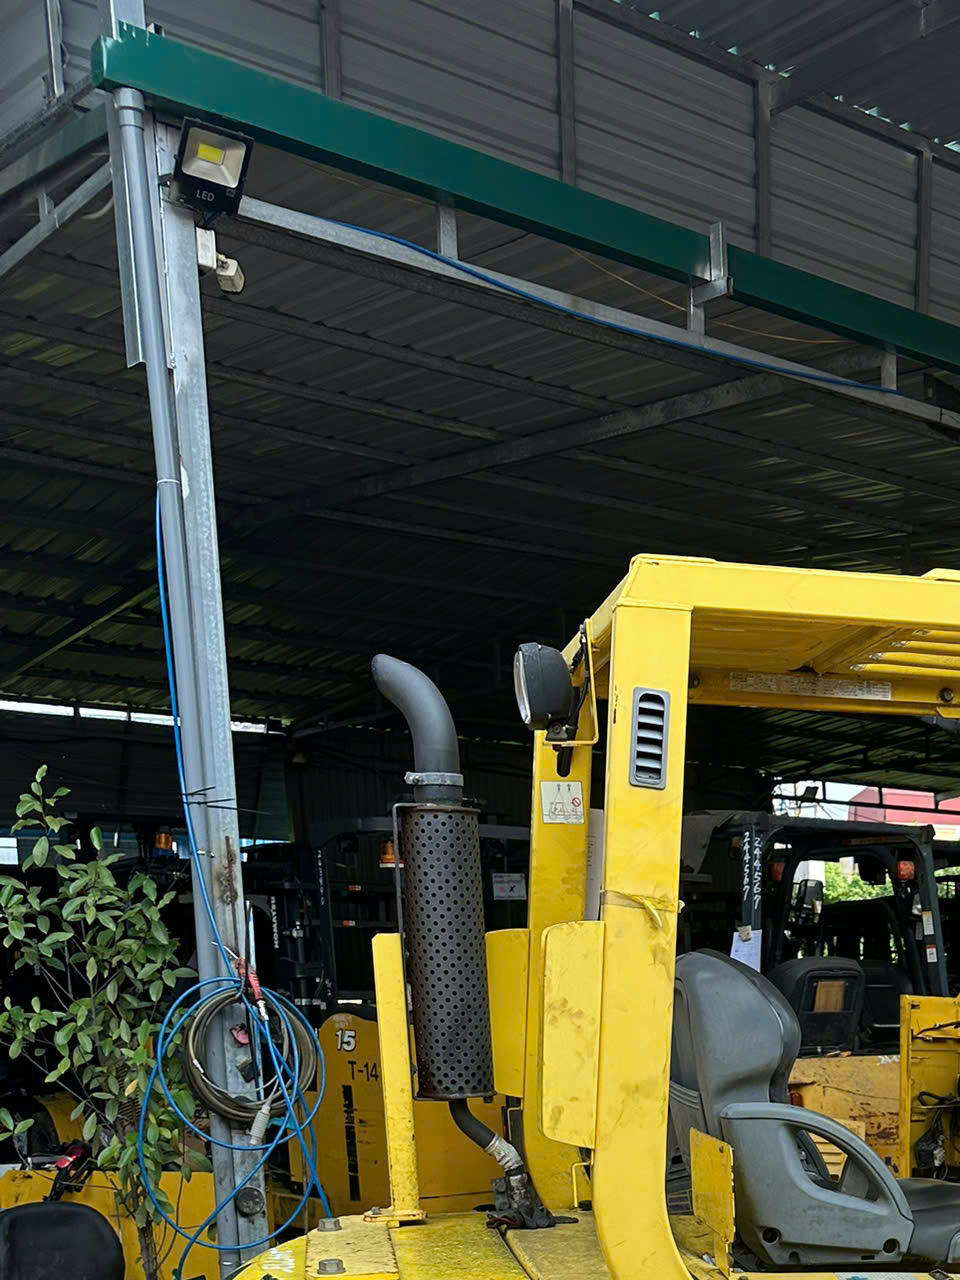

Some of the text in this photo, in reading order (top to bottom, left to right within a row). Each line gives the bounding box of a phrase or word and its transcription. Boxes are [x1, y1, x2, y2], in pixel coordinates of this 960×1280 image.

[196, 189, 215, 202] LED
[270, 896, 280, 949] KOMATSU
[336, 1029, 356, 1052] 15
[347, 1060, 379, 1082] T-14
